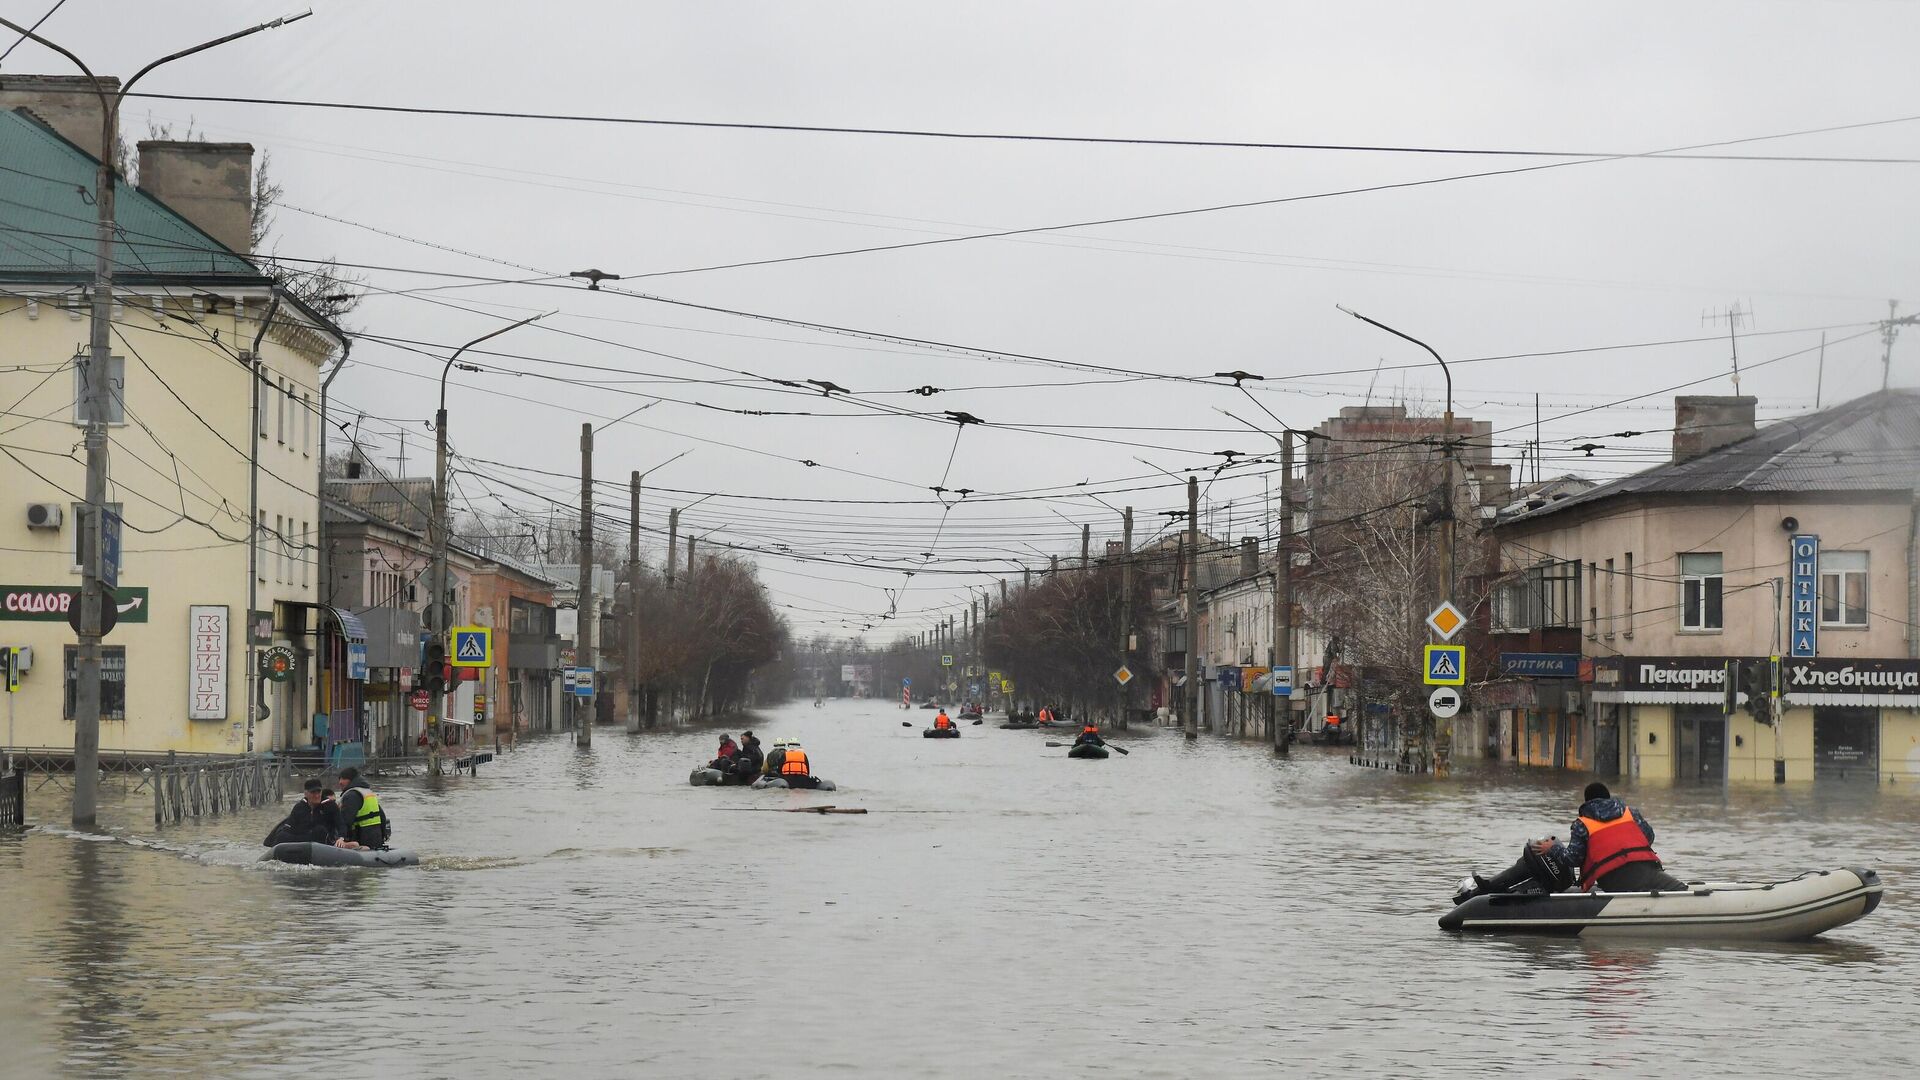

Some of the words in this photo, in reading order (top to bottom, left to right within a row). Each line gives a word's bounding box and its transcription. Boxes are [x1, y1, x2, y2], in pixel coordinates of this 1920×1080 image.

[1797, 543, 1813, 650] ОПТИКА
[196, 615, 221, 711] КНИГИ
[262, 647, 277, 668] АПТЕКА
[277, 646, 296, 670] САДОВОДА
[1507, 659, 1564, 671] ОПТИКА
[1639, 664, 1726, 689] Пекарня
[1791, 665, 1919, 690] Хлебница
